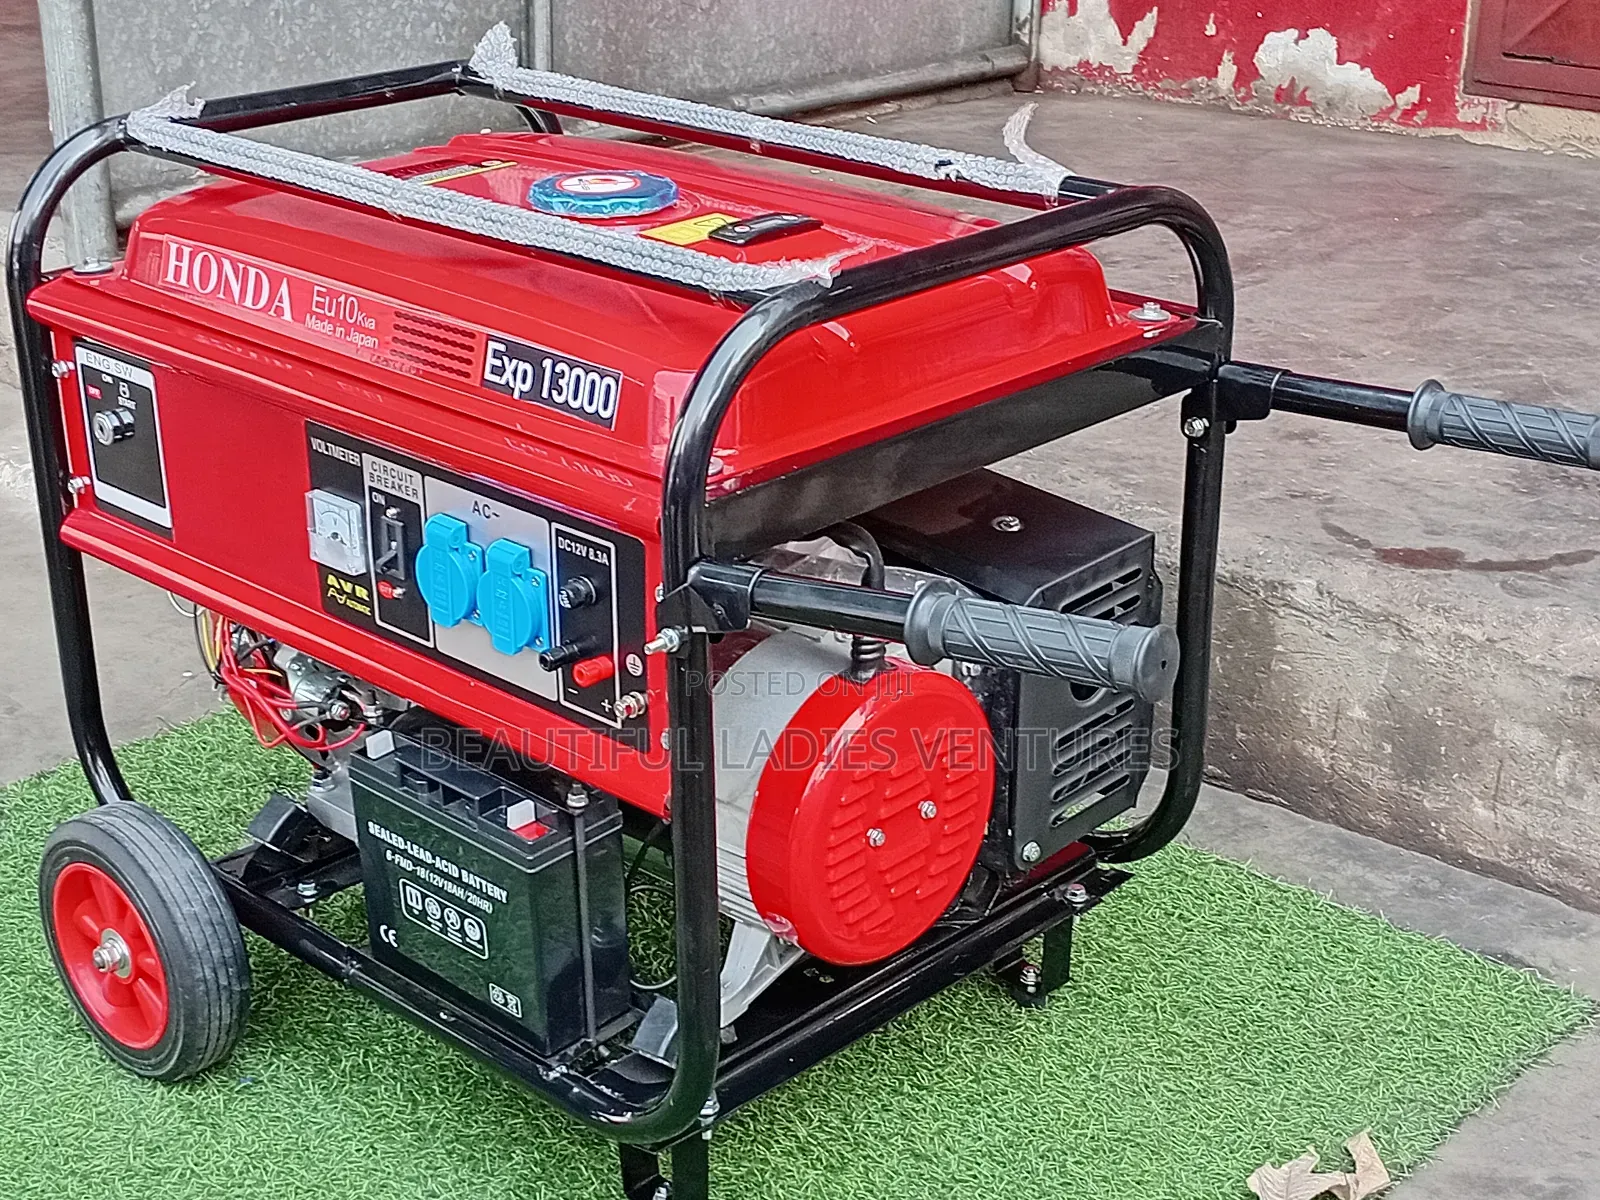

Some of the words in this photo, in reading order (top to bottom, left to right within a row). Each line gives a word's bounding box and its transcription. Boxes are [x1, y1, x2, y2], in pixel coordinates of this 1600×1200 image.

[164, 241, 295, 323] HONDA
[304, 313, 334, 336] Made
[334, 323, 345, 339] in
[346, 327, 379, 349] Japan
[483, 339, 535, 400] Exp
[540, 357, 618, 420] 13000
[310, 436, 361, 467] VOLTMETER
[368, 471, 419, 500] BREAKER
[370, 460, 414, 486] CIRCUIT
[371, 491, 386, 506] ON
[327, 574, 370, 601] AVR
[460, 868, 508, 904] BATTERY
